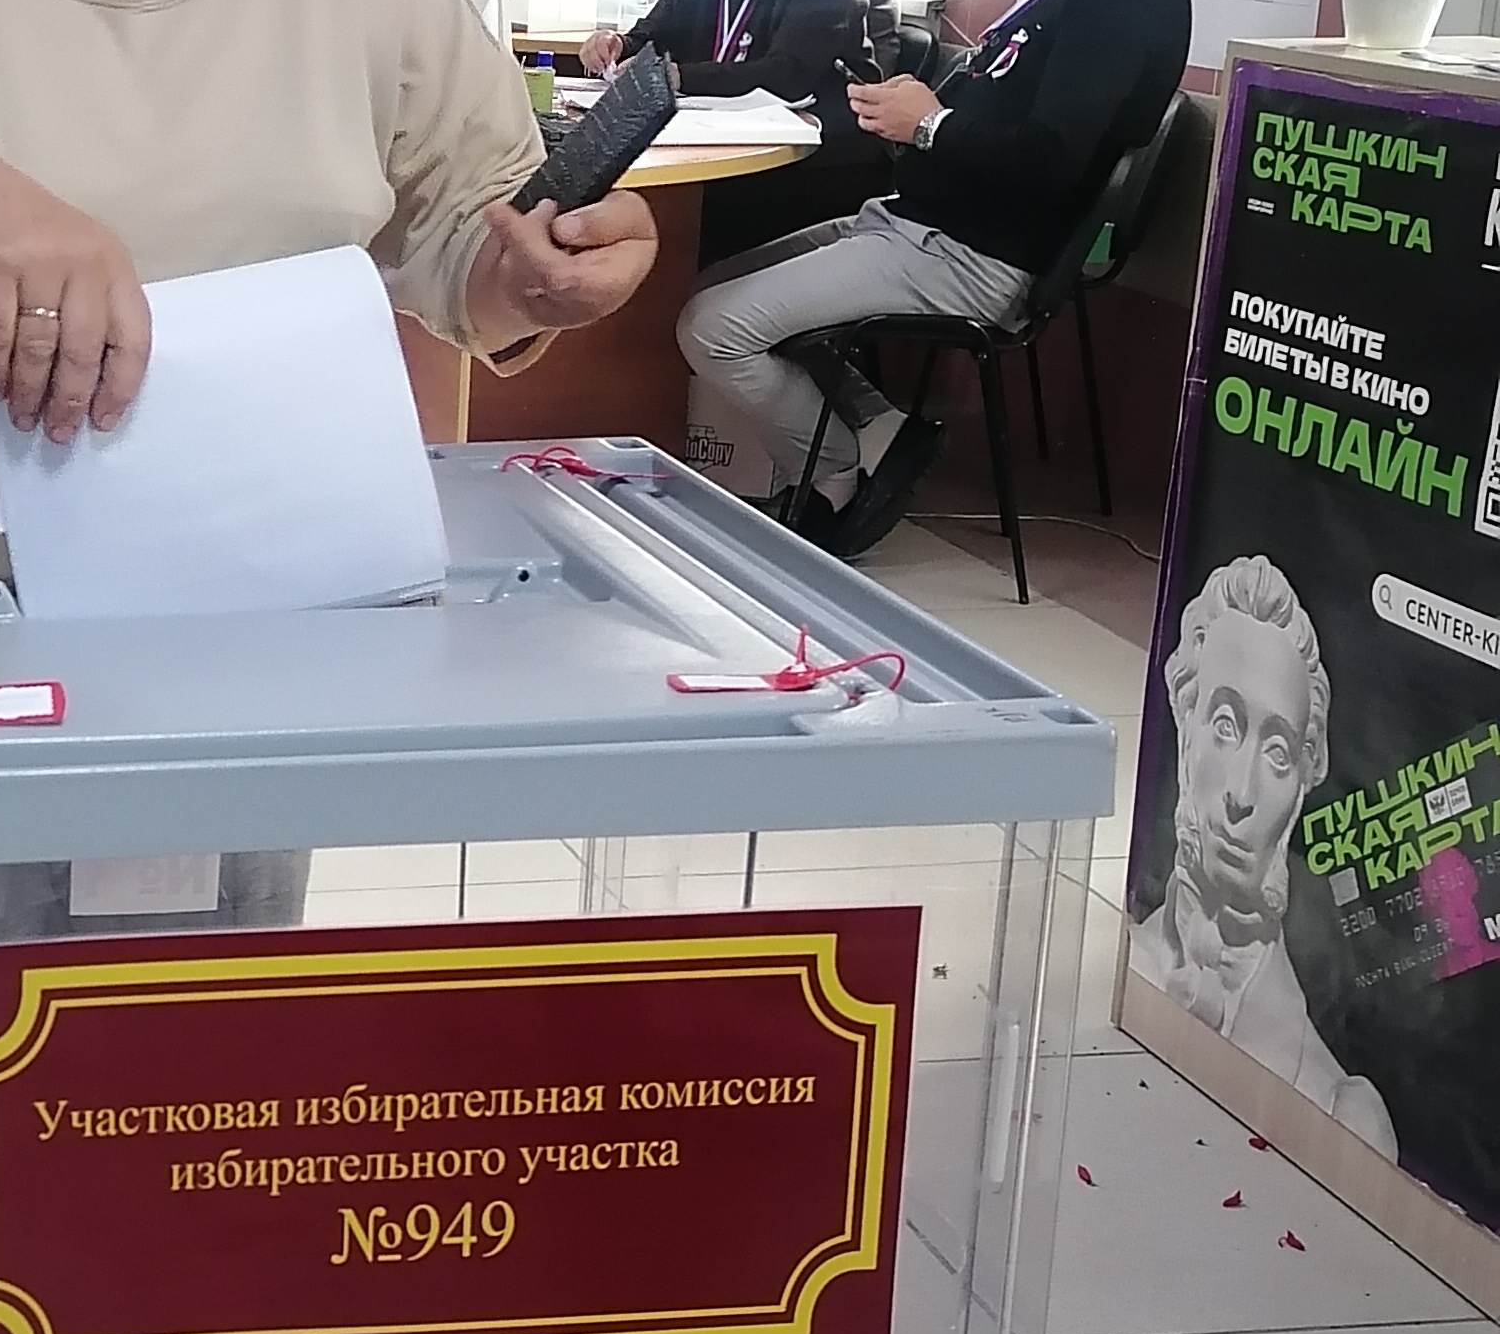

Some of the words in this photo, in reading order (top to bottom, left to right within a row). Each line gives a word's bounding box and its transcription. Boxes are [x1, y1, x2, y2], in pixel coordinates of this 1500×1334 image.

[1252, 147, 1361, 199] СКАЯ
[1255, 112, 1447, 179] ПУШКИН
[1291, 190, 1432, 253] КАРТА
[1230, 290, 1386, 360] ПОКУПАЙТЕ
[1224, 327, 1329, 385] БИЛЕТЫ
[1331, 362, 1349, 391] В
[1350, 366, 1430, 416] КИНО
[1214, 375, 1469, 518] ОНЛАЙН
[1405, 599, 1500, 656] CENTER-KI
[1303, 723, 1500, 845] ПУШКИН
[1307, 798, 1428, 875] СКАЯ
[1364, 799, 1500, 890] КАРТ
[32, 1099, 281, 1142] Участковая
[295, 1083, 606, 1133] избирательная
[618, 1074, 817, 1111] комиссия
[169, 1148, 507, 1197] избирательного
[517, 1138, 681, 1185] участка
[329, 1199, 517, 1266] №949
